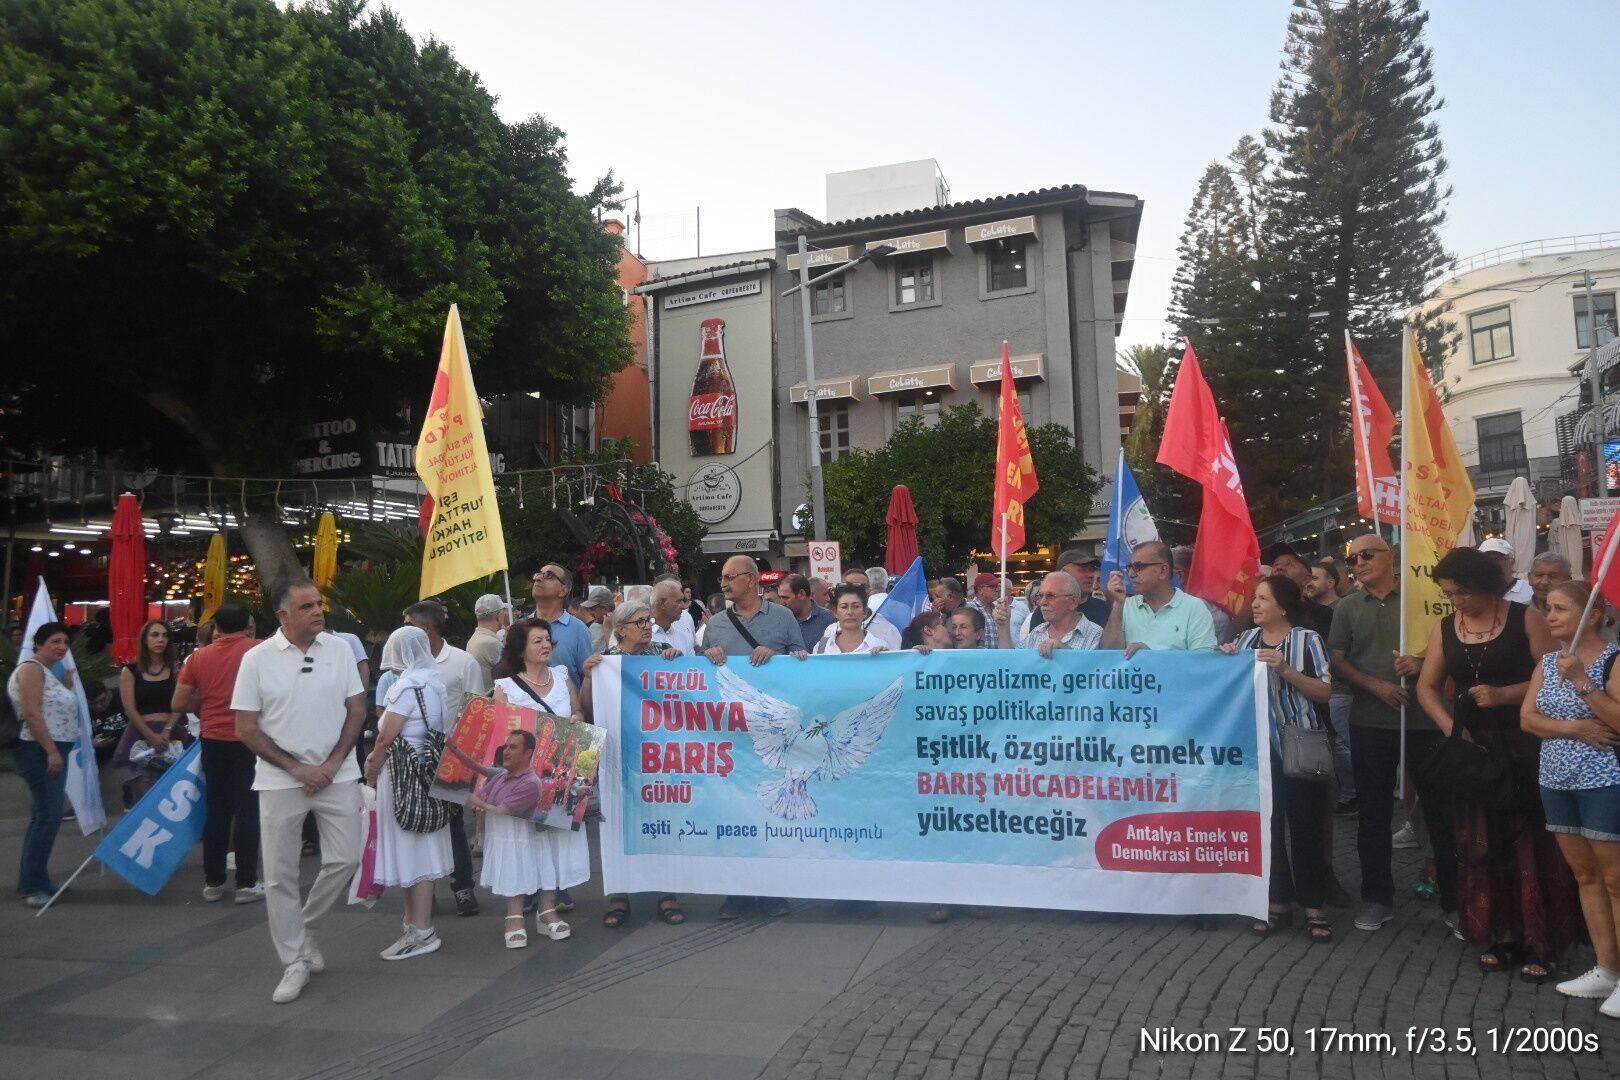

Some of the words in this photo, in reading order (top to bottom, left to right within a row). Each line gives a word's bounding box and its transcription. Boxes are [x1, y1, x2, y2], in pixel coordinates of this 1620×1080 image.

[807, 254, 833, 264] eLatte
[640, 671, 649, 690] 1
[656, 669, 708, 691] EYLÜL
[915, 670, 1057, 694] Emperyalizme,
[1063, 671, 1162, 694] gericiliğe,
[641, 694, 749, 732] DÜNYA
[915, 704, 968, 727] savaş
[974, 700, 1104, 725] politikalarına
[1110, 701, 1158, 729] karşı
[641, 741, 735, 778] BARIŞ
[917, 736, 997, 765] Eşitlik,
[1004, 736, 1124, 767] özgürlük,
[1130, 739, 1205, 765] emek
[1211, 747, 1244, 766] ve
[641, 781, 692, 804] GÜNÜ
[917, 771, 987, 803] BARIŞ
[994, 768, 1178, 803] MÜCADELEMİZİ
[642, 820, 671, 840] aşiti
[678, 820, 708, 842] سلام
[716, 823, 758, 840] peace
[918, 807, 1088, 842] yükselteceğiz
[1127, 825, 1182, 844] Antalya
[1186, 827, 1227, 843] Emek
[1231, 830, 1248, 843] ve
[1112, 844, 1190, 862] Demokrasi
[1195, 846, 1249, 866] Güçleri
